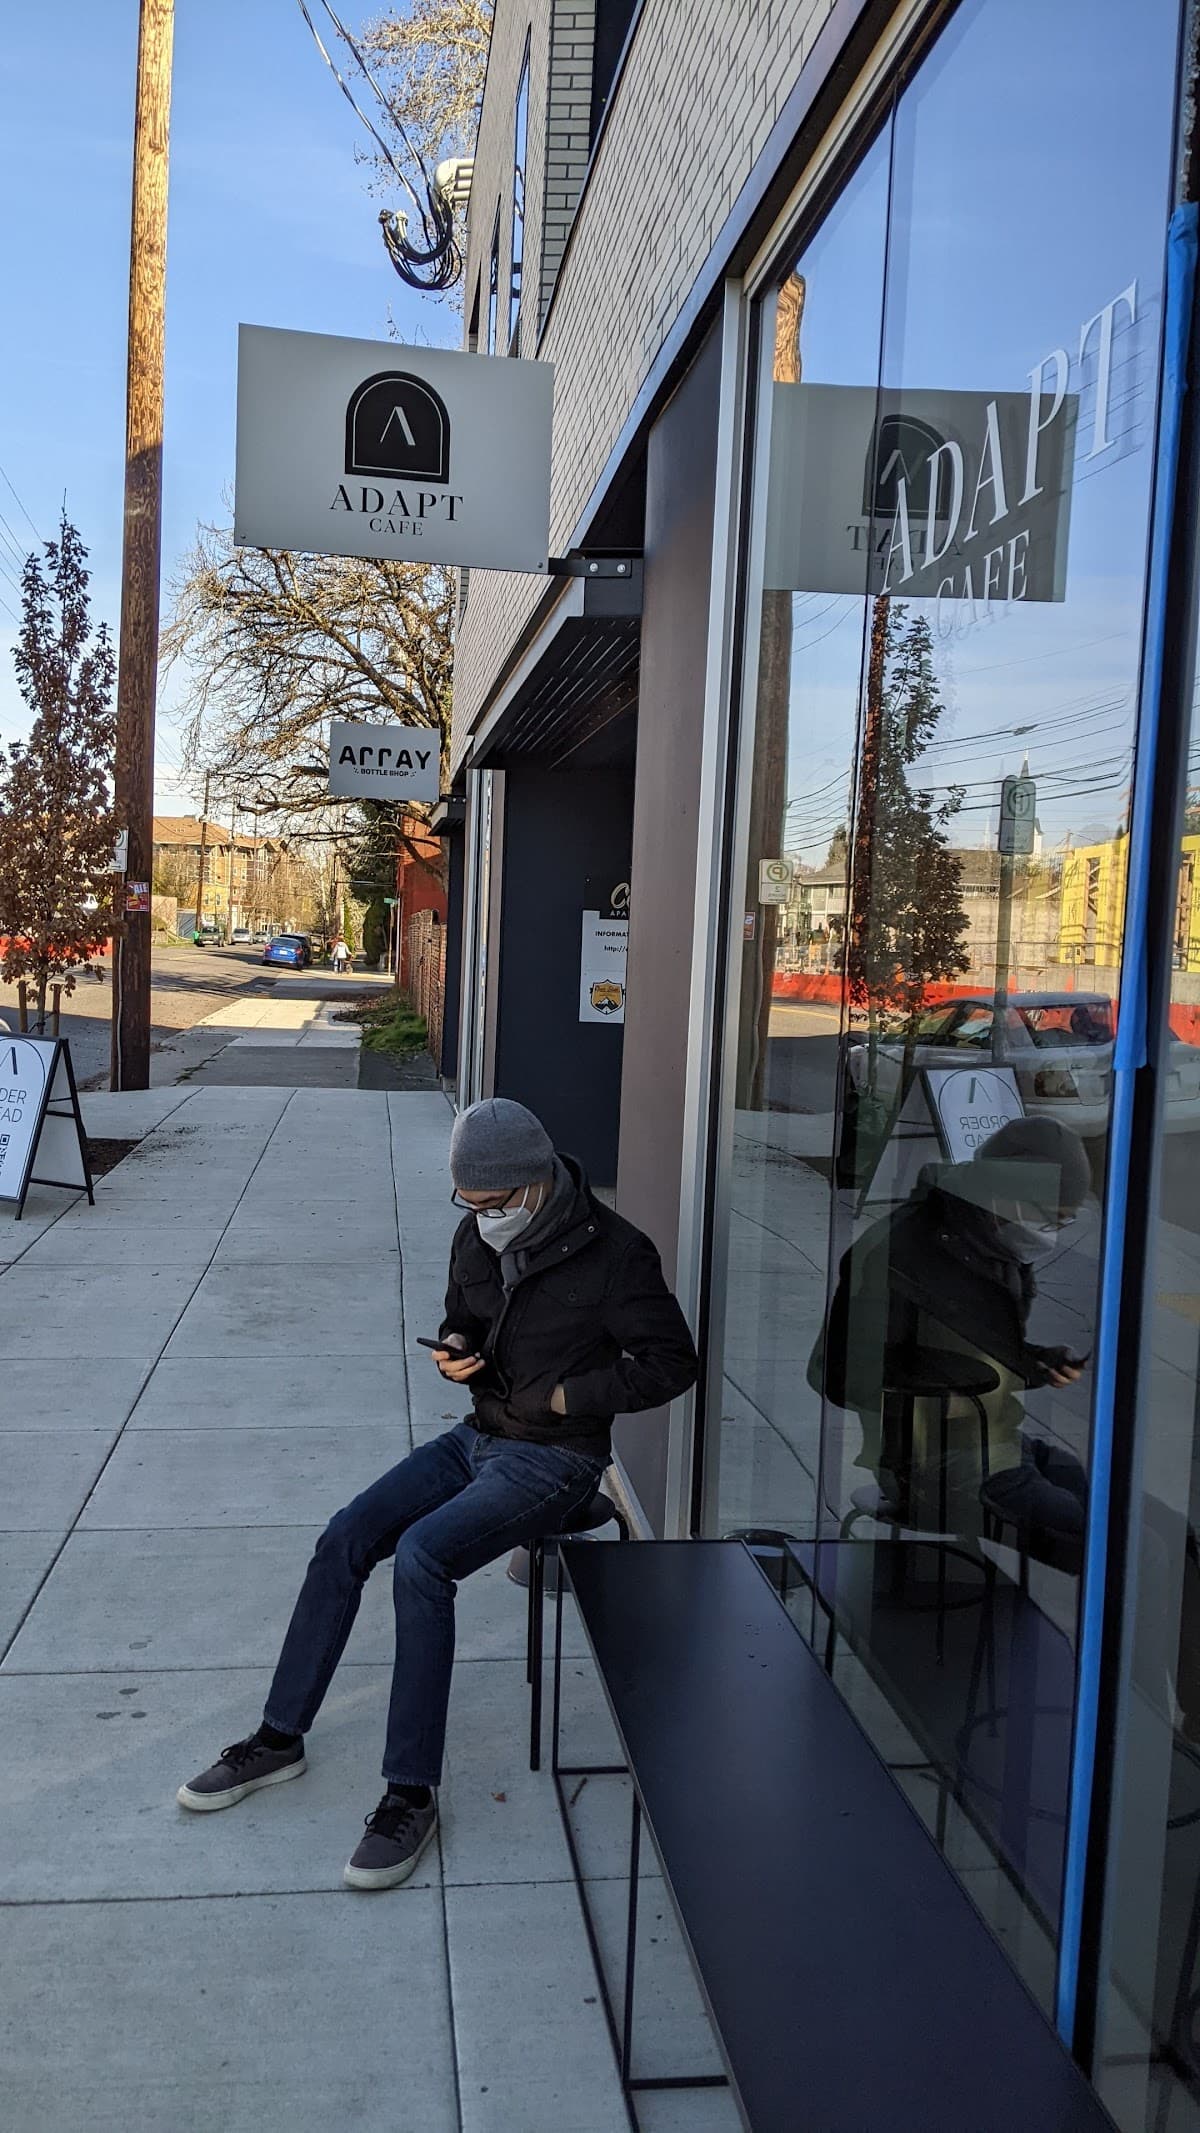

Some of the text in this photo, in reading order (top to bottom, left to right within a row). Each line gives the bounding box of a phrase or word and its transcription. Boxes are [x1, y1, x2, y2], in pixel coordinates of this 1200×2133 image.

[879, 278, 1138, 597] ADAPT
[328, 484, 464, 522] ADAPT
[369, 518, 424, 536] CAFE
[935, 529, 1030, 640] CAFE
[360, 768, 388, 776] BOTTLE
[0, 1106, 23, 1123] AD
